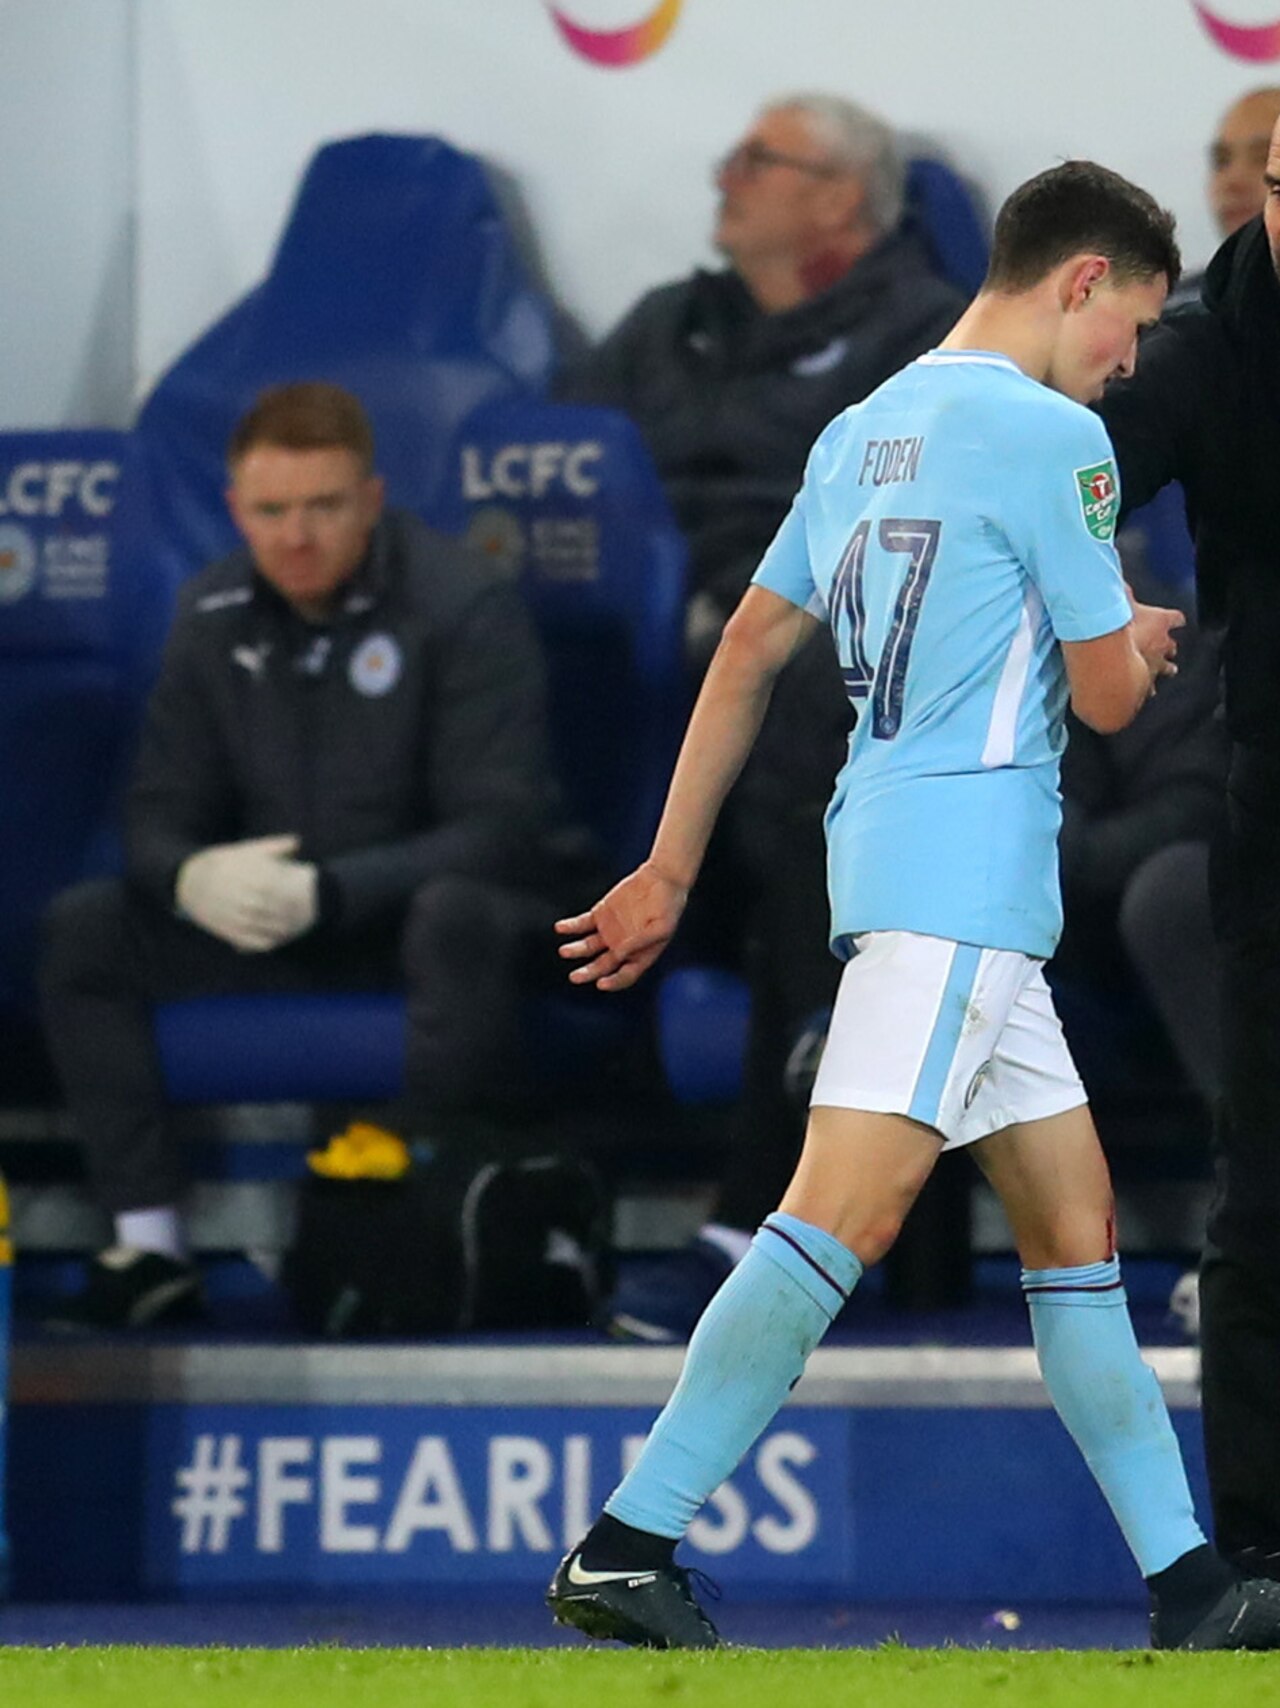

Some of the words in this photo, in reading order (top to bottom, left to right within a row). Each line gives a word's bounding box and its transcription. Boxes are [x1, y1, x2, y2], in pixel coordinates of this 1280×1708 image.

[0, 461, 120, 517] CFC
[461, 440, 604, 498] LCFC
[858, 436, 924, 487] FODEN
[828, 518, 941, 741] 47
[172, 1432, 818, 1554] #FEARLSS
